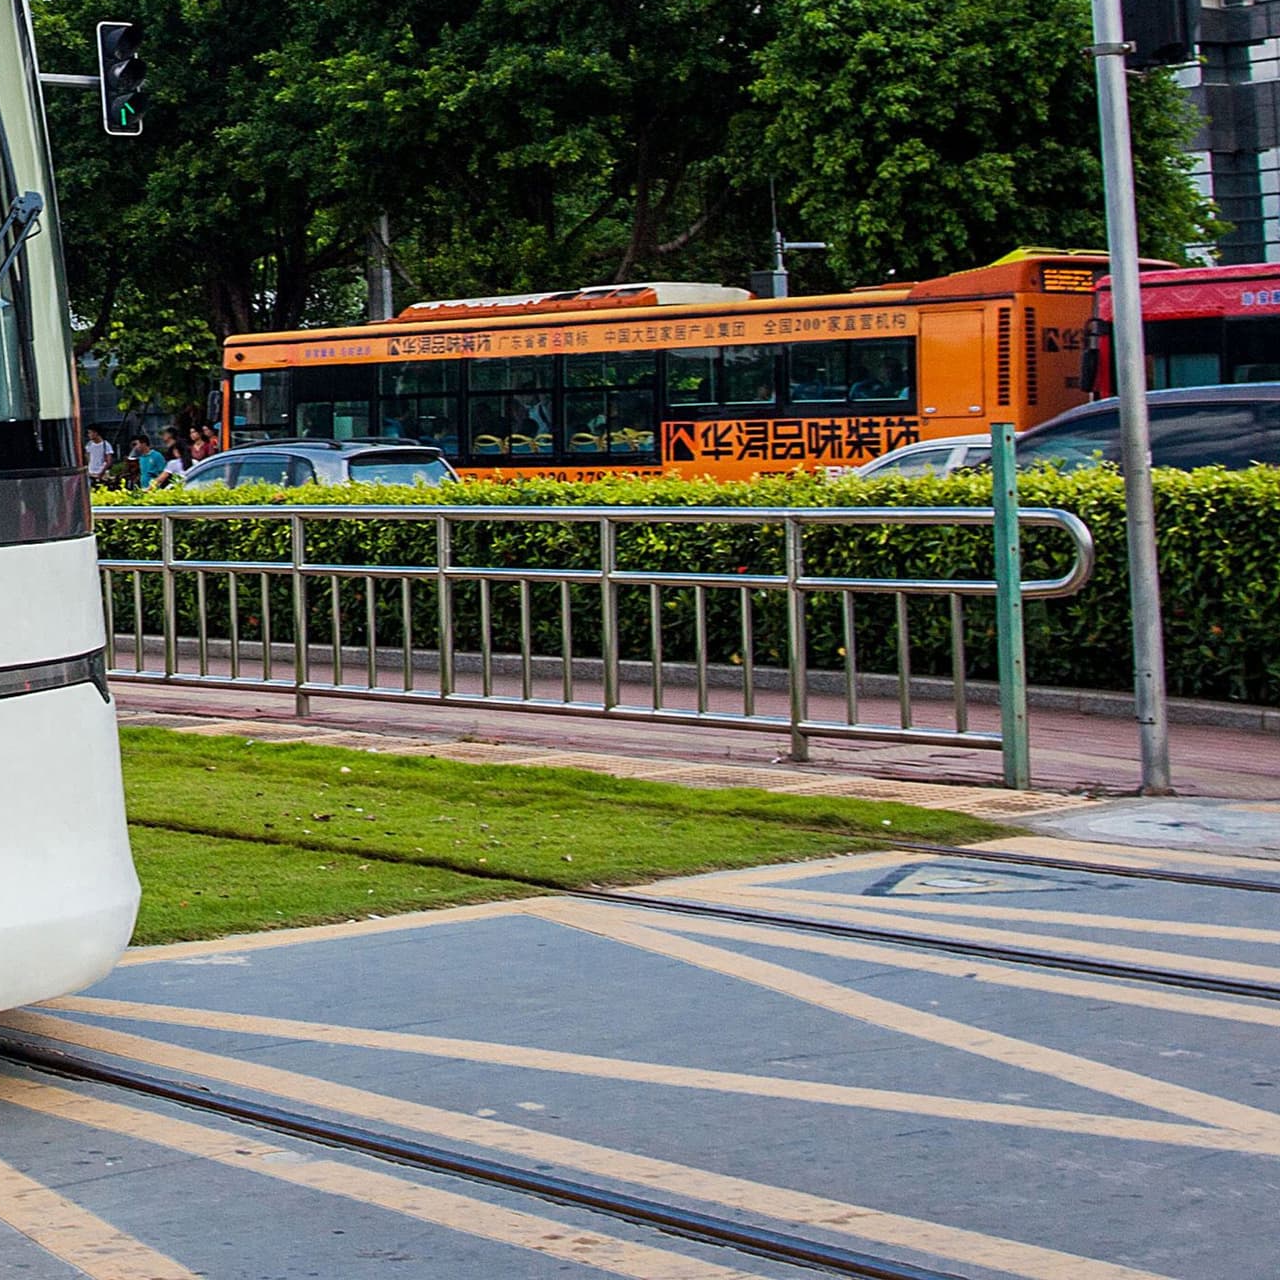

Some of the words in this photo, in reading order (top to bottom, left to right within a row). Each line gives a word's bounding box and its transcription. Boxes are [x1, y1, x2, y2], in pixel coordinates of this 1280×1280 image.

[498, 331, 589, 351] 广东省著名商标
[604, 322, 745, 343] 中国大型家居产业集团
[700, 418, 920, 460] 华浔品味装饰
